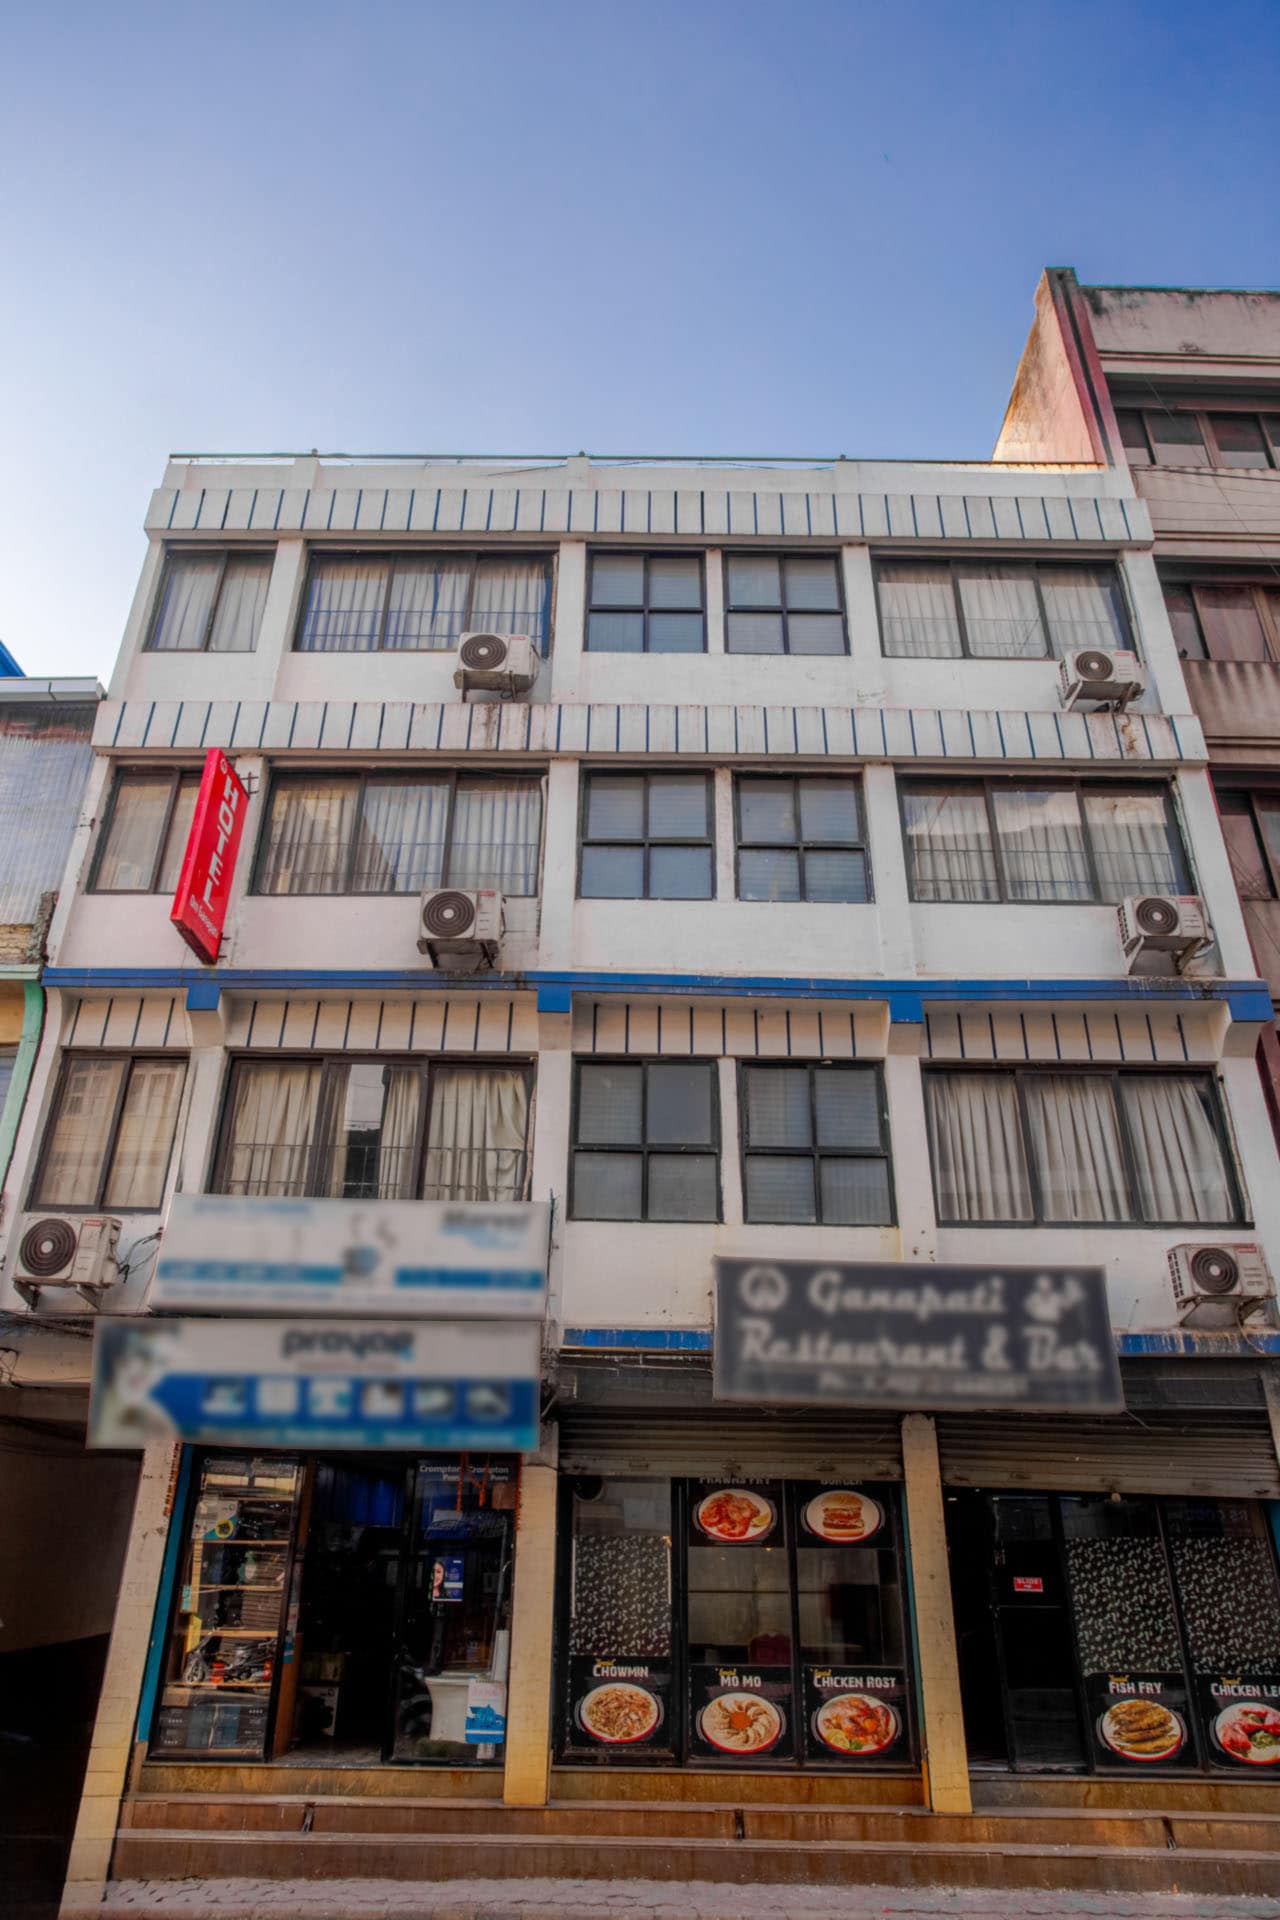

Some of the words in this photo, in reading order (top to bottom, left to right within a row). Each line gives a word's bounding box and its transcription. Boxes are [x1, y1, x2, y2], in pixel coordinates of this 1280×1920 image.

[203, 775, 239, 912] HOTEL
[592, 1664, 649, 1678] CHOWMIN
[720, 1675, 739, 1687] MO
[742, 1675, 762, 1688] MO
[813, 1674, 864, 1688] CHICKEN
[866, 1675, 896, 1688] ROST
[1108, 1681, 1136, 1694] FISH
[1138, 1681, 1162, 1694] FRY
[1210, 1682, 1261, 1697] CHICKEN
[1262, 1684, 1280, 1697] LE
